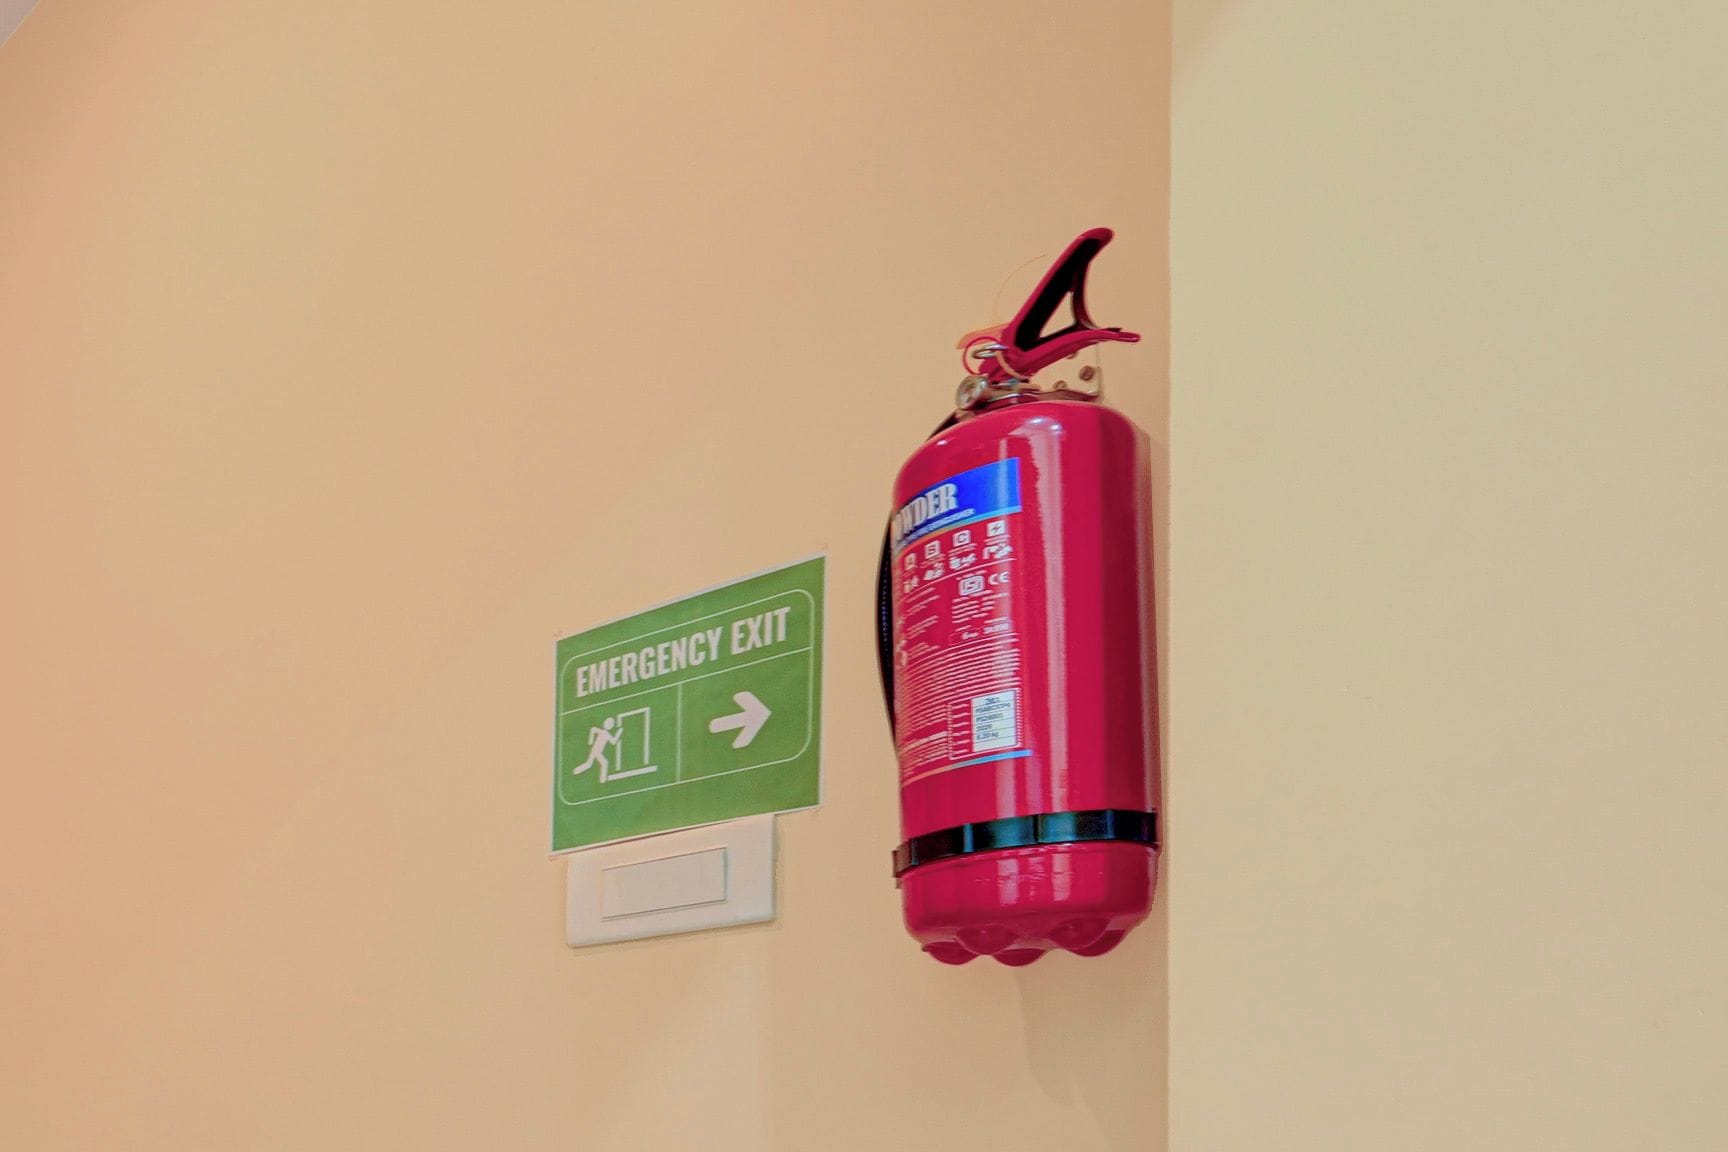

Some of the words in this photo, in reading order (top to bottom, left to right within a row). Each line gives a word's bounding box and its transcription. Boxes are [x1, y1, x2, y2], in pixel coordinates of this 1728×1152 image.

[892, 483, 959, 542] OWDER
[576, 627, 722, 698] EMERGENCY
[731, 606, 791, 656] EXIT
